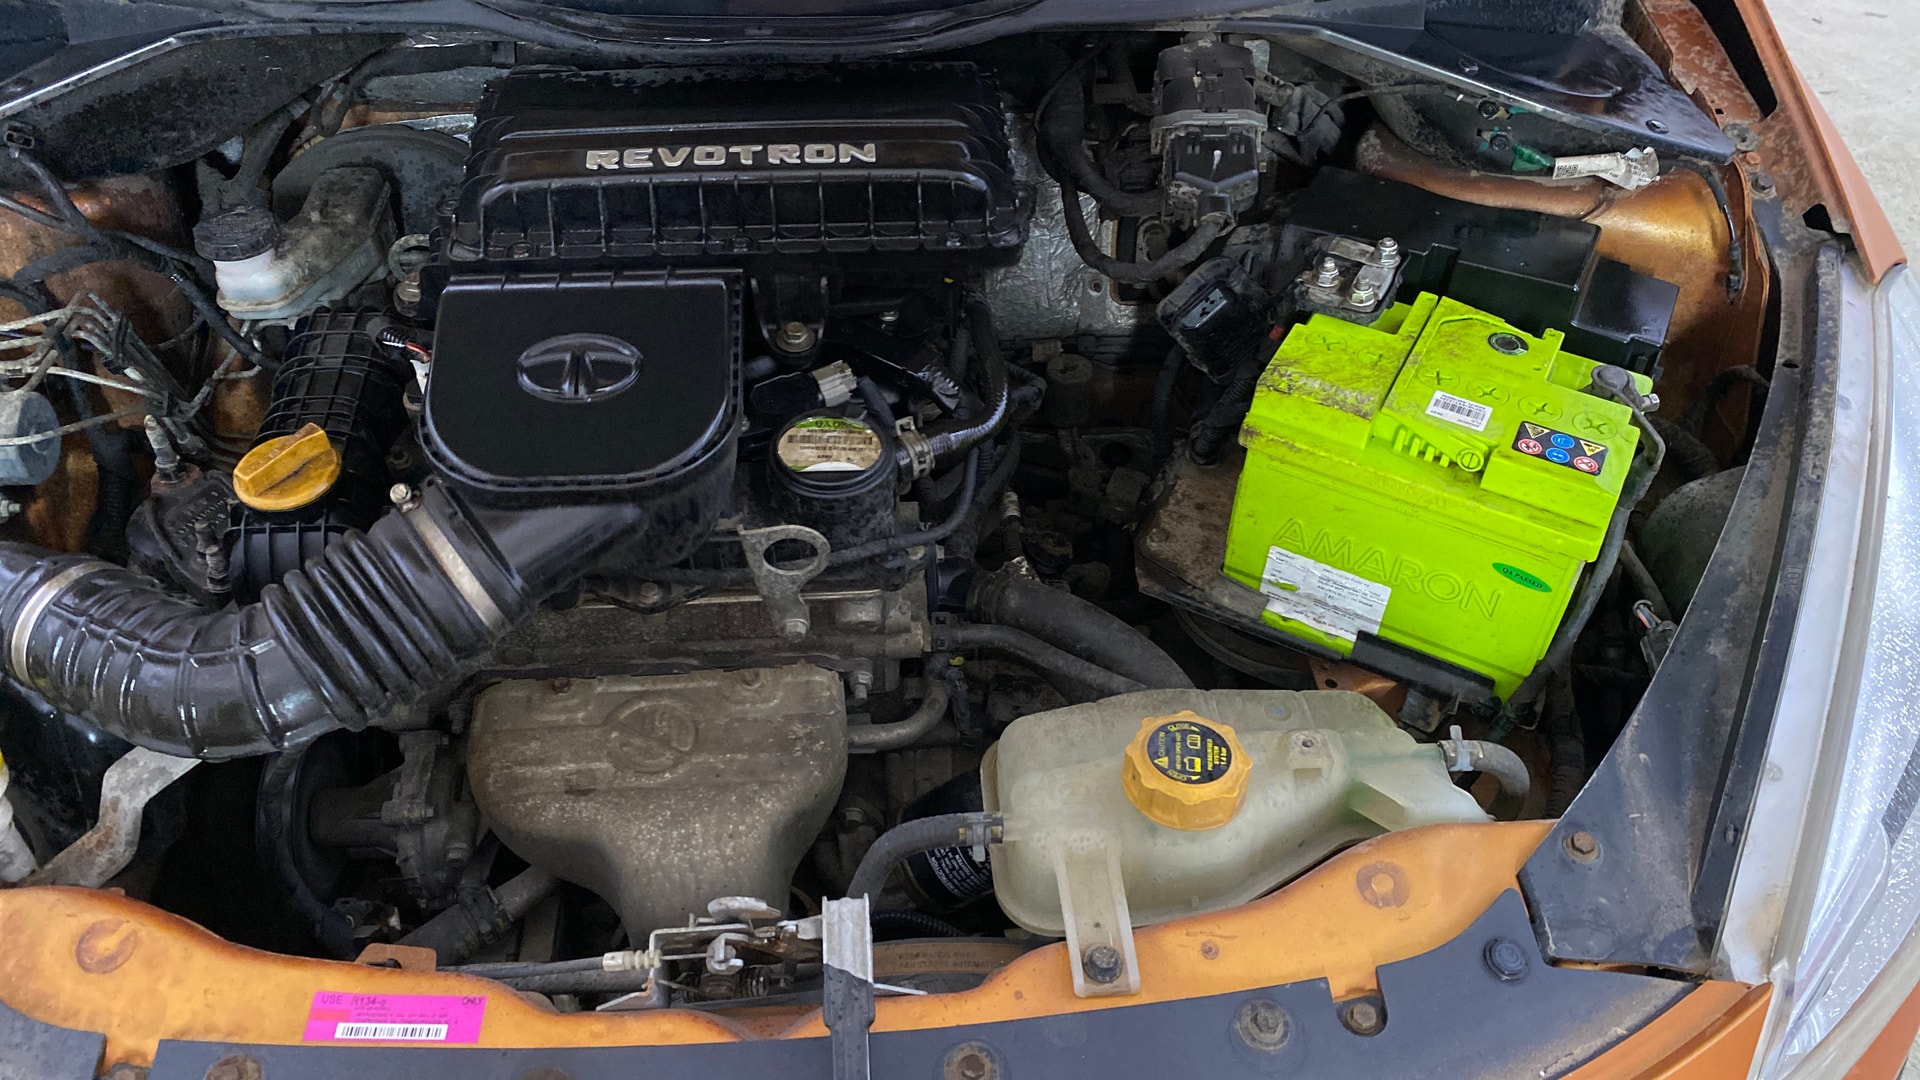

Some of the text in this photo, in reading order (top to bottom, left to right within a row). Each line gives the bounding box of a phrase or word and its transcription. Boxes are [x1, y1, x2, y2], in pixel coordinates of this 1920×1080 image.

[585, 143, 877, 170] REVOTRON
[1274, 517, 1505, 620] AMARON
[1501, 566, 1544, 590] QA PASSED
[322, 994, 344, 1005] USE
[461, 996, 484, 1006] ONLY
